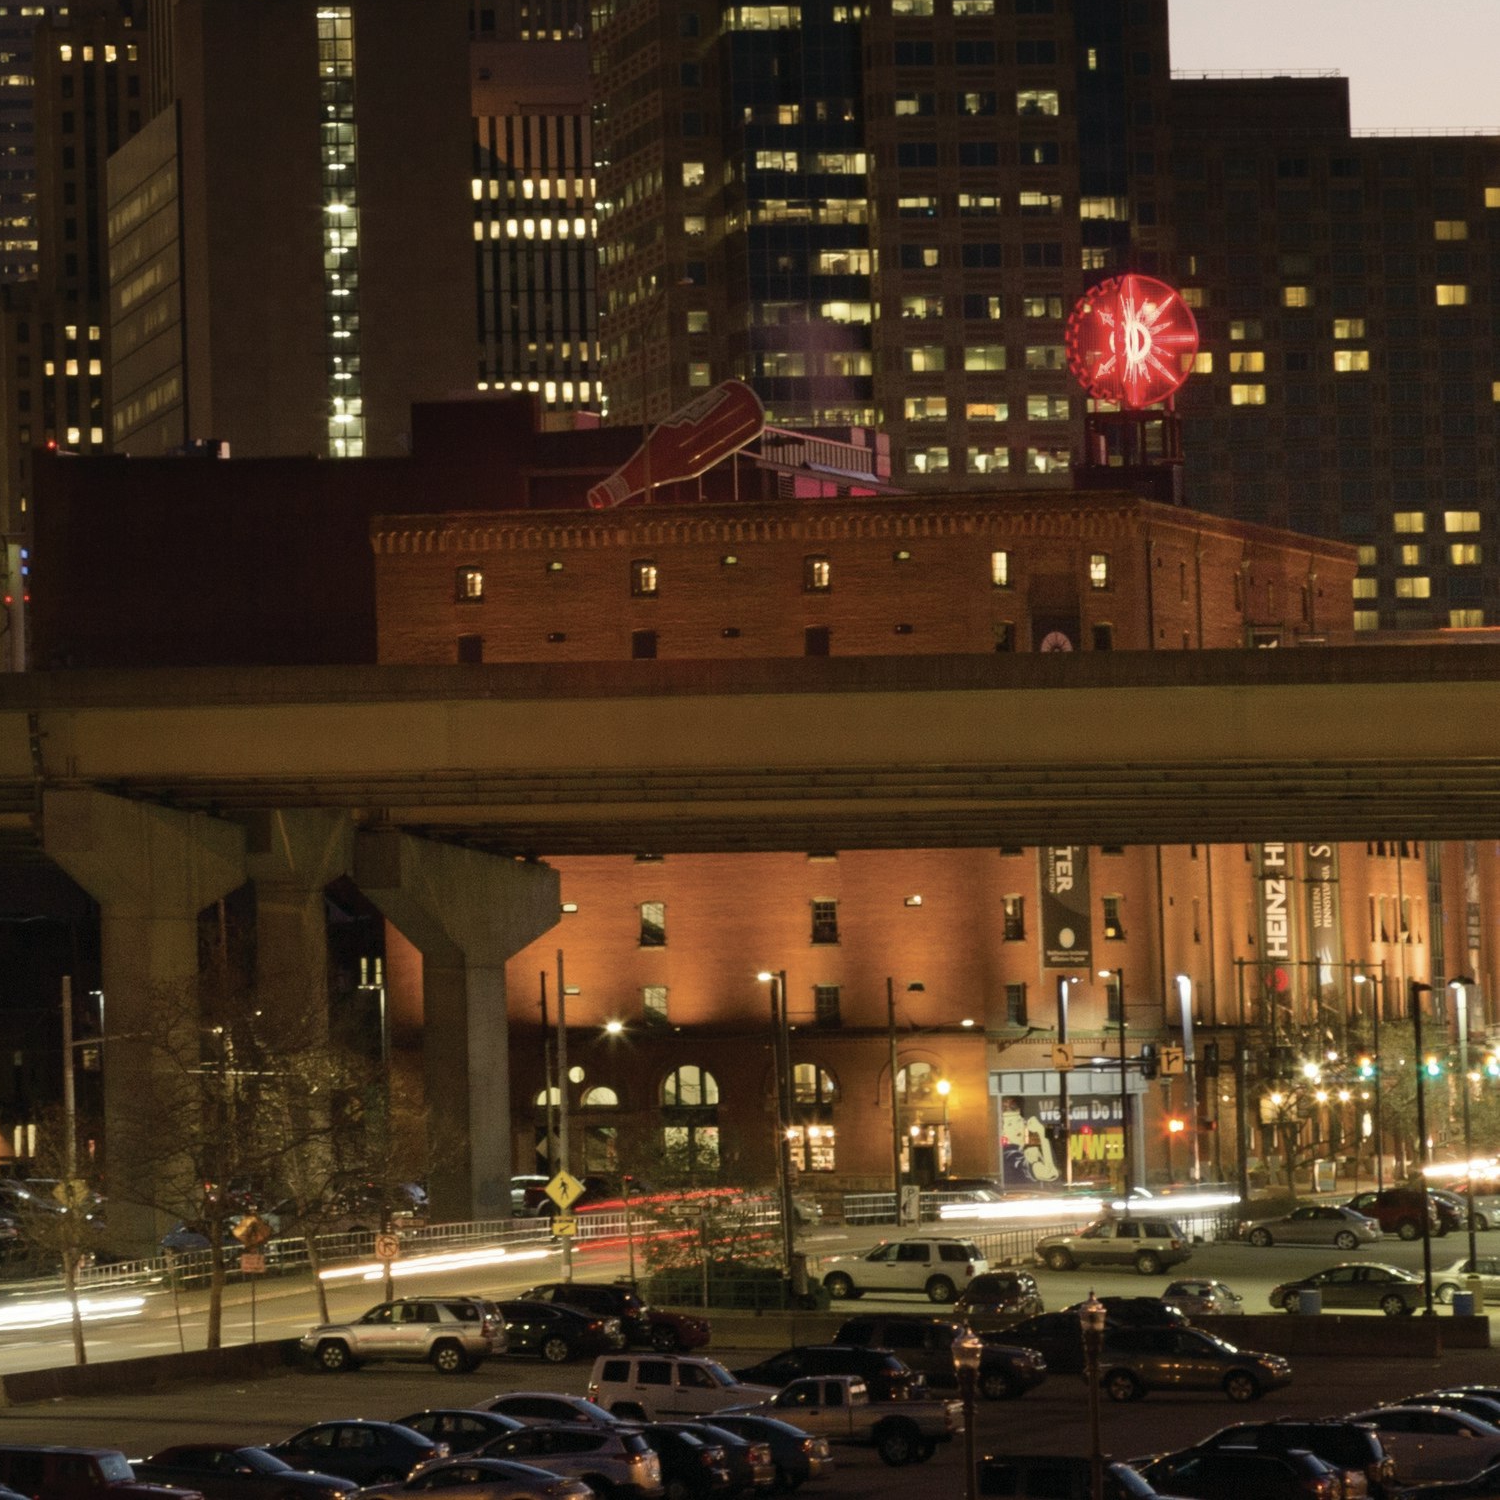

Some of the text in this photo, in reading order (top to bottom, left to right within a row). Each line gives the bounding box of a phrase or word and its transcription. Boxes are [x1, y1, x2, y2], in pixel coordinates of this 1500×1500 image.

[1265, 878, 1288, 957] HEINZ
[1312, 887, 1322, 928] WESTERN
[1039, 1100, 1061, 1121] We
[1092, 1100, 1109, 1120] Do
